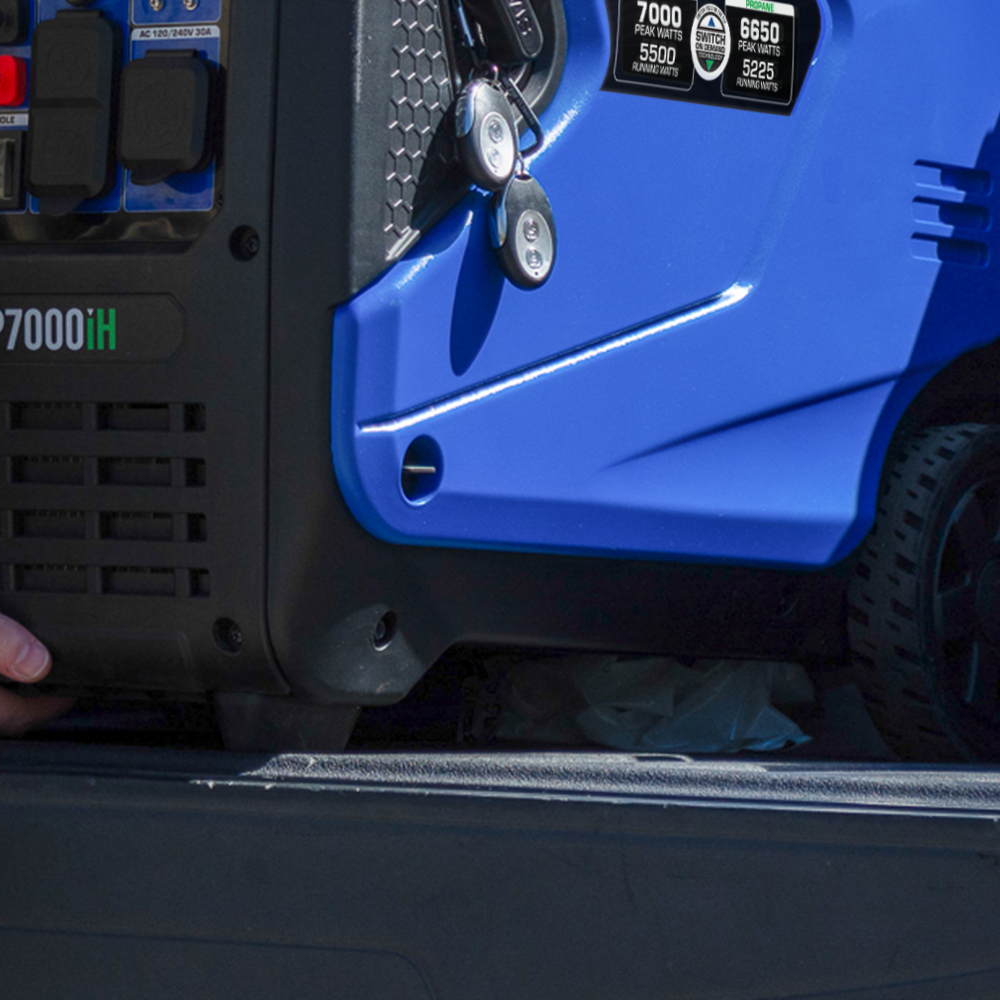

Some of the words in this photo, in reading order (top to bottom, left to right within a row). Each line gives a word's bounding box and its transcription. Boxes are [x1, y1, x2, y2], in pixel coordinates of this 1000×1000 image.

[637, 1, 682, 28] 7000
[745, 0, 774, 13] PROPANE
[139, 29, 152, 38] AC
[153, 27, 194, 37] 120/240V
[195, 27, 211, 36] 30A
[634, 23, 656, 38] PEAK
[657, 26, 683, 41] WATTS
[696, 31, 726, 45] SWITCH
[740, 17, 780, 44] 6650
[639, 43, 676, 65] 5500
[738, 40, 756, 53] PEAK
[757, 43, 781, 57] WATTS
[632, 63, 659, 75] RUNNING
[660, 65, 679, 78] WATTS
[742, 58, 774, 80] 5225
[736, 76, 759, 89] RUNNING
[760, 79, 779, 92] WATTS
